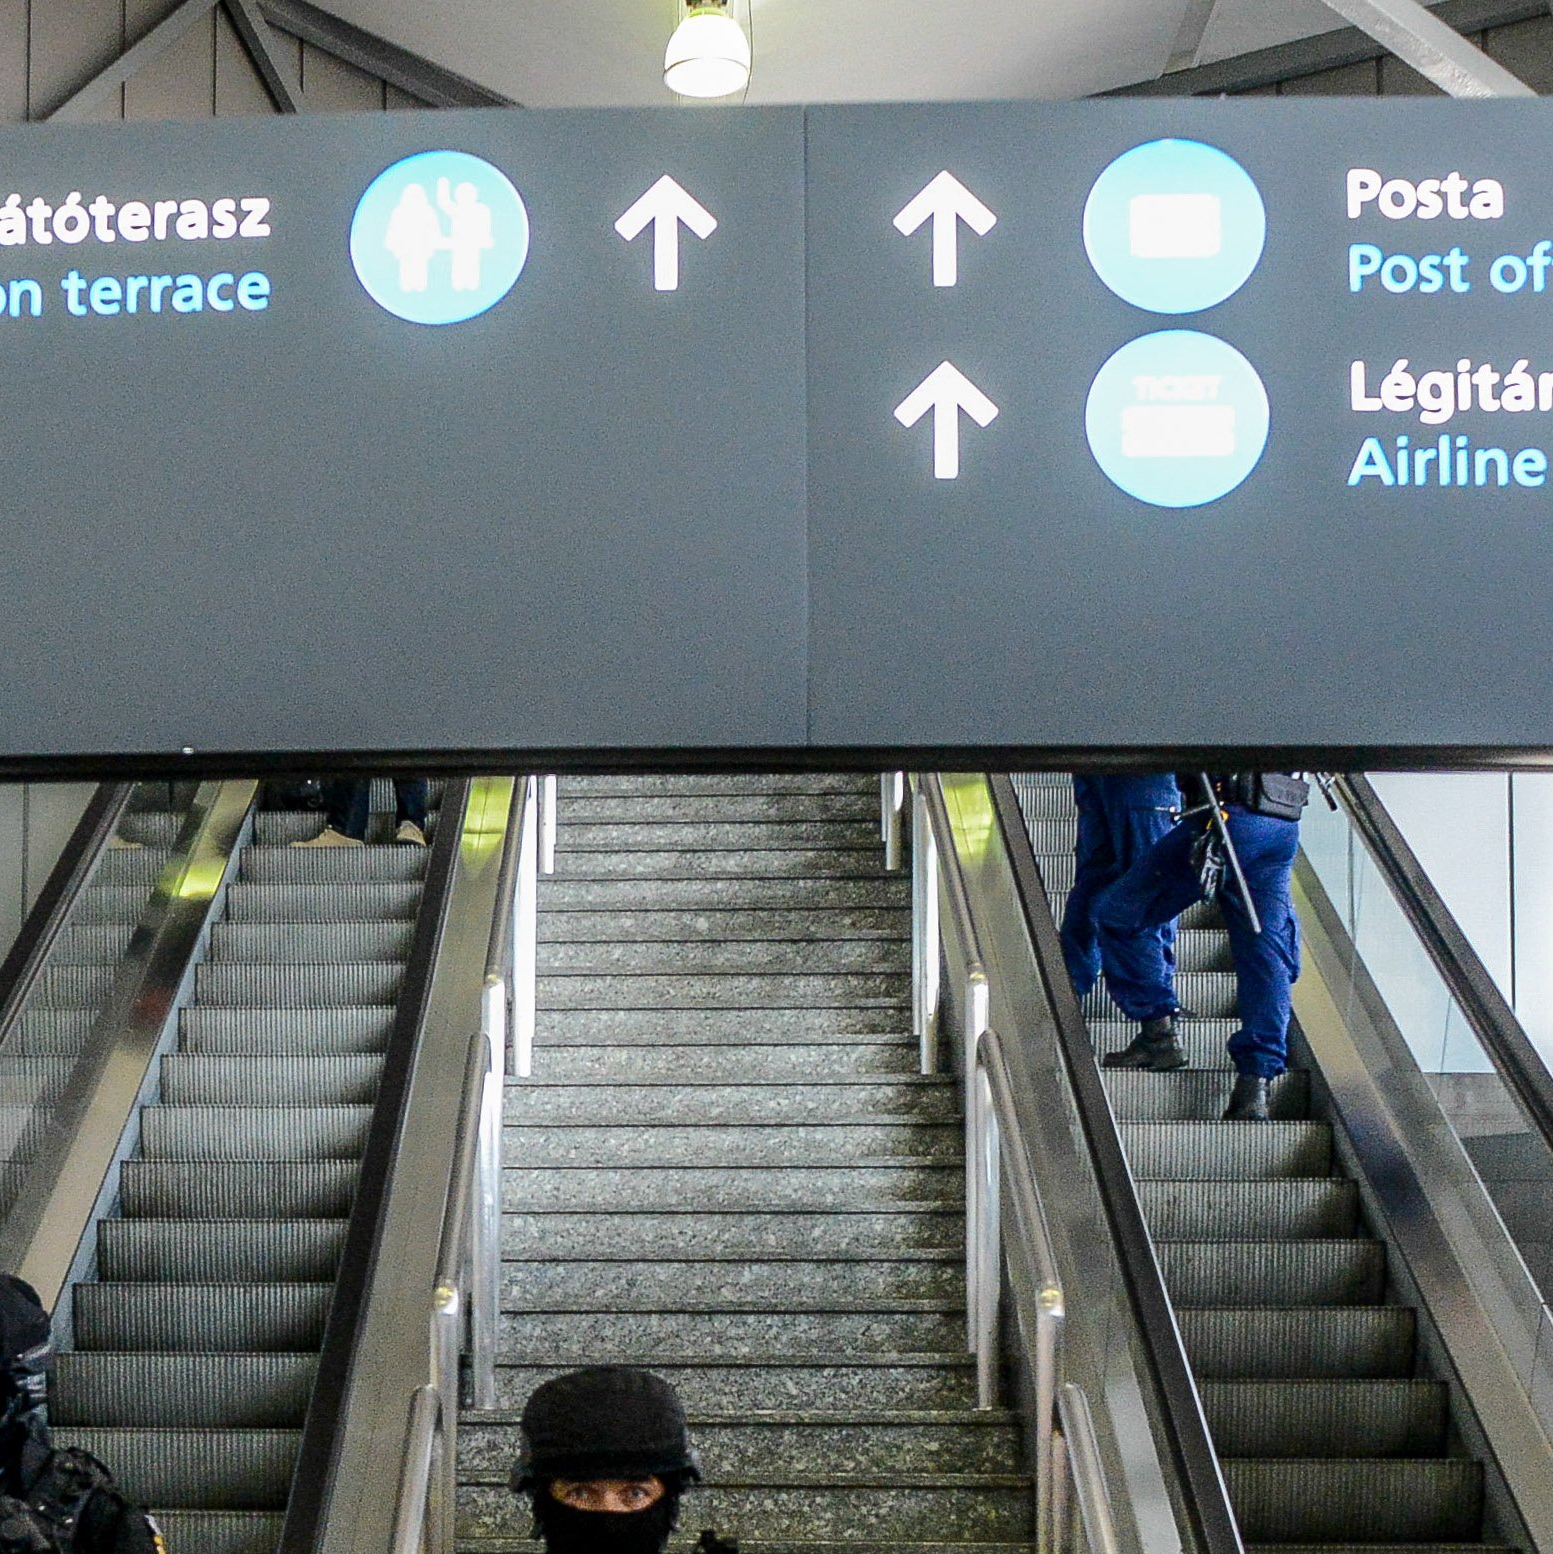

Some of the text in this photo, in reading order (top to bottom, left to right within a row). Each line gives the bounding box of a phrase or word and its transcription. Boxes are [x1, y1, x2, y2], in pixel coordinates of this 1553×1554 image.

[1346, 168, 1505, 220] Posta
[60, 269, 271, 316] terrace
[1348, 243, 1472, 294] Post
[1347, 434, 1548, 488] Airline
